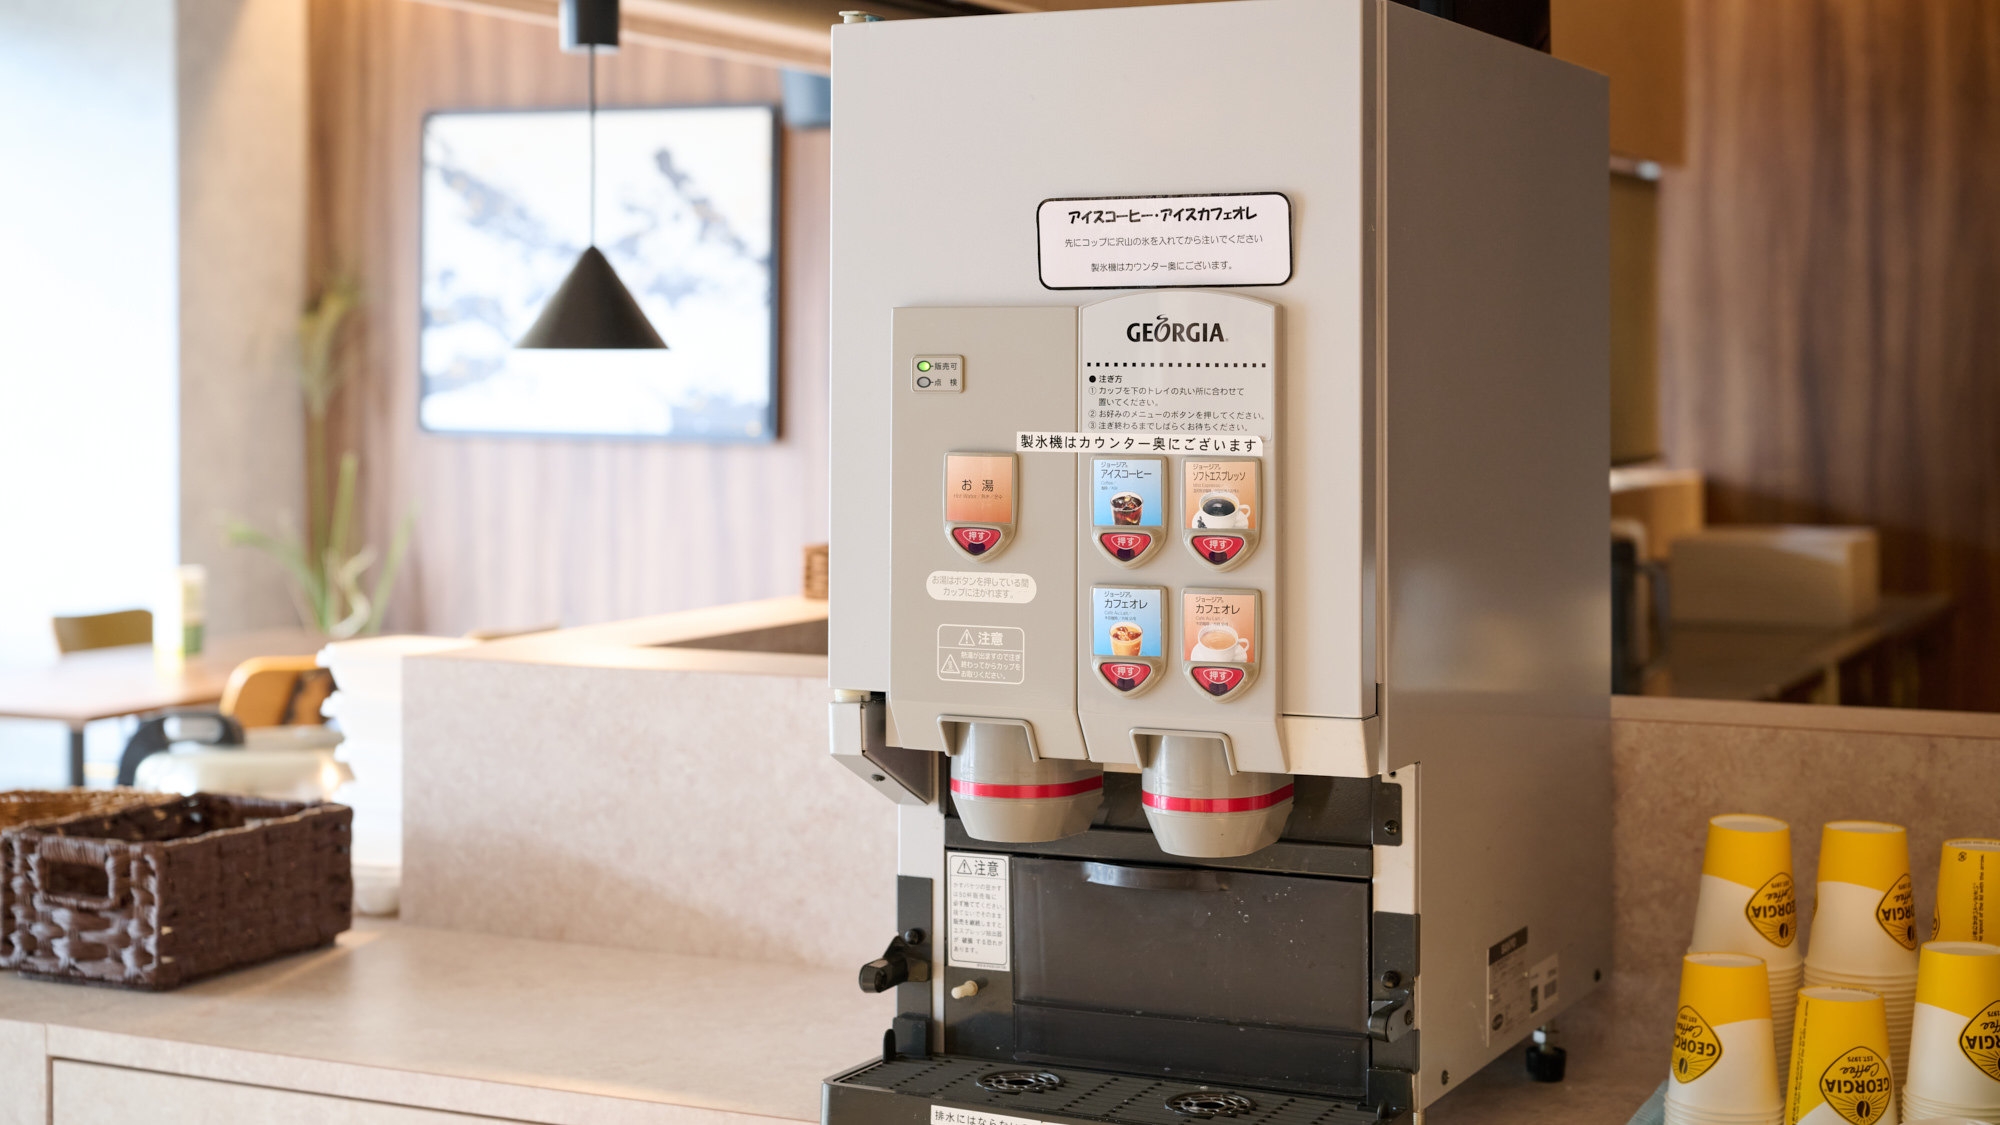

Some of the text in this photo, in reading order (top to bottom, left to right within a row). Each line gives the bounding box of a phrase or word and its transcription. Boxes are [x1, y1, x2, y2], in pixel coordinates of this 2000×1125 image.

[1068, 205, 1257, 224] アイスコーヒー・アイスカフェオレ
[1064, 234, 1263, 248] 先にコップに沢山の氷を入れてから注いでください
[1091, 260, 1233, 273] 製氷機はカウンター奥にございます。
[1126, 314, 1225, 343] GEORGIA
[934, 362, 957, 371] 販売可
[1098, 375, 1123, 383] 注ぎ方
[1099, 386, 1244, 396] カップを下のトレイの丸い所に合わせて
[1098, 397, 1159, 407] 置いてください。
[1099, 410, 1265, 420] お好みのメニューのボタンを押してください。
[1098, 421, 1248, 431] 注ぎ終わるまでしばらくお待ちください。
[1020, 433, 1257, 453] 製氷機はカウンター奥にございます
[1101, 469, 1152, 479] アイスコーヒー
[1193, 471, 1246, 481] ソフトエスプレッソ
[968, 531, 985, 541] 押す
[1117, 536, 1135, 546] 押す
[1209, 539, 1227, 549] 押す
[931, 576, 1030, 588] お湯はボタンを押している間
[943, 588, 1013, 599] カップに注がれます。
[1104, 599, 1148, 610] カフェオレ
[1196, 604, 1240, 615] カフェオレ
[977, 631, 1004, 646] 注意
[1116, 666, 1135, 676] 押す
[1209, 670, 1228, 680] 押す
[974, 859, 999, 877] 注意
[1752, 899, 1796, 918] EORGIA
[1673, 1033, 1716, 1057] GEORG
[1839, 1062, 1880, 1079] Coffee
[1824, 1077, 1890, 1094] GEORGIA
